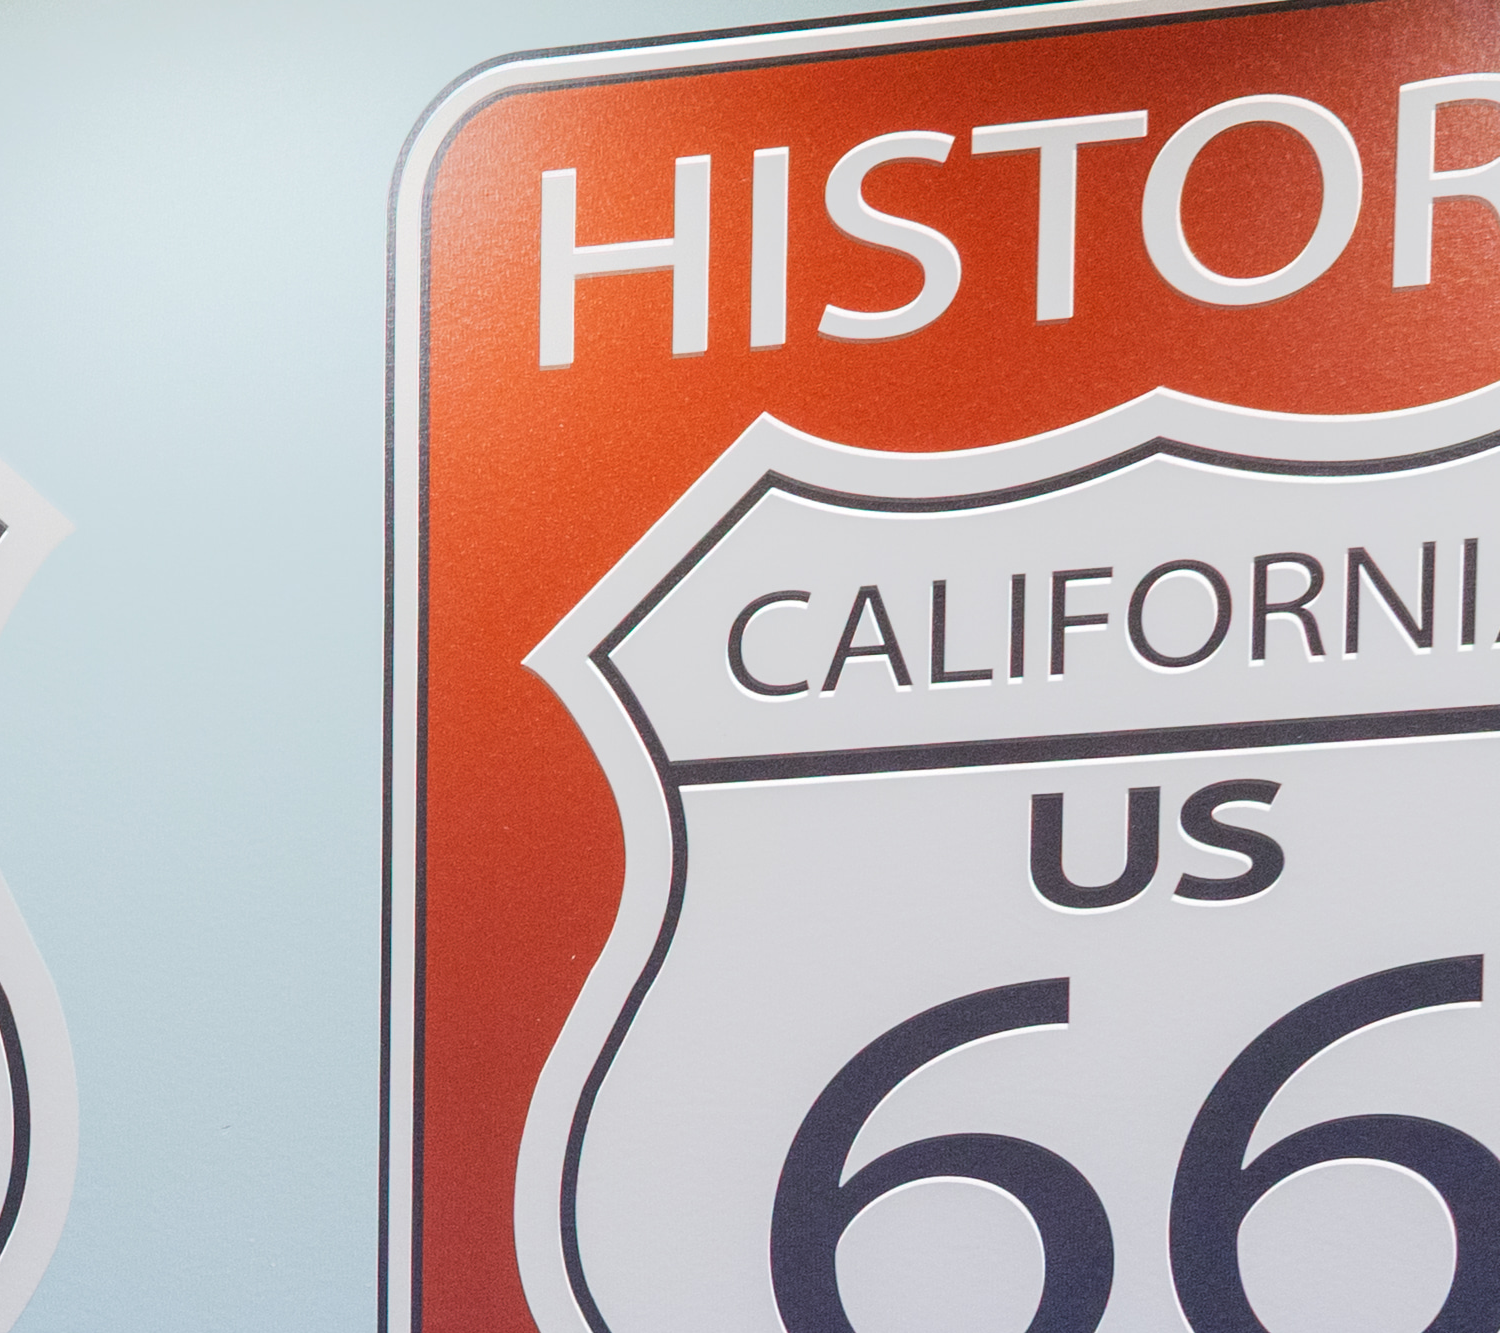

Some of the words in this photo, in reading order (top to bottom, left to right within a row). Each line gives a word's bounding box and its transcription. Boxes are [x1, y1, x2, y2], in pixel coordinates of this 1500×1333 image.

[540, 72, 1500, 371] HISTOR
[726, 537, 1500, 702] CALIFORNI
[1029, 778, 1285, 910] US
